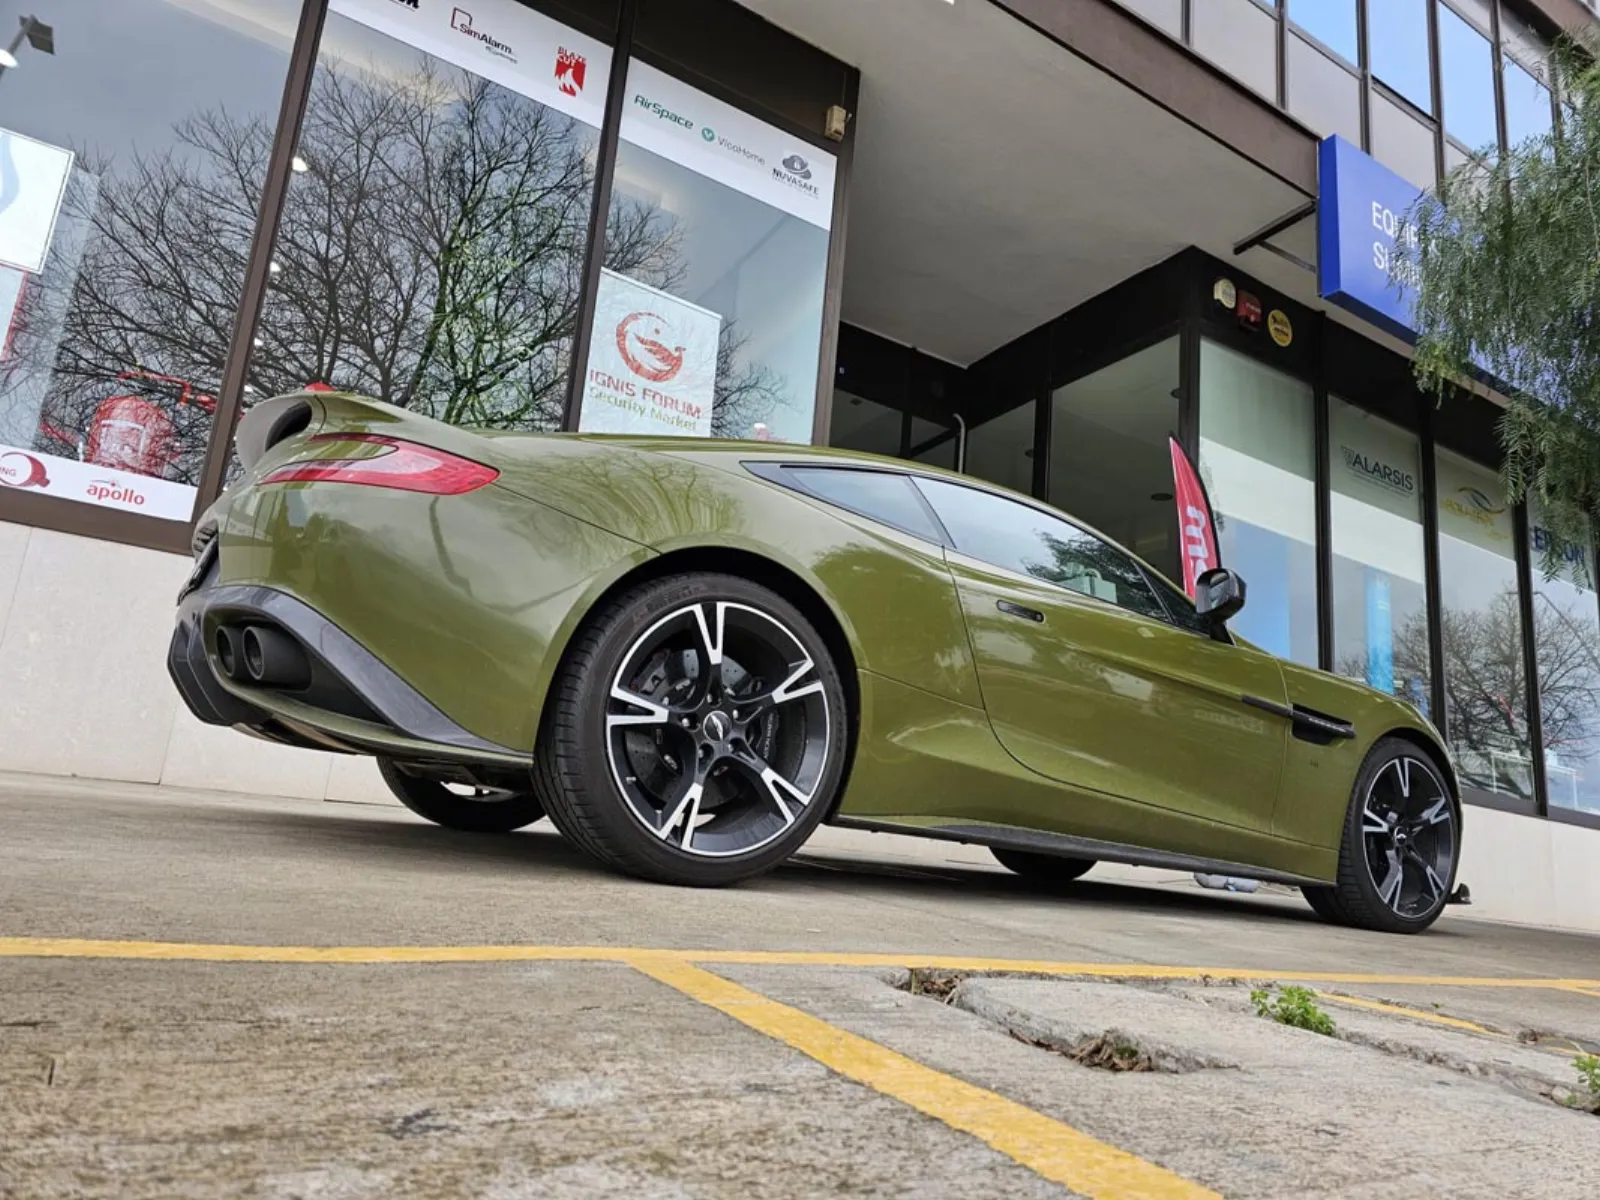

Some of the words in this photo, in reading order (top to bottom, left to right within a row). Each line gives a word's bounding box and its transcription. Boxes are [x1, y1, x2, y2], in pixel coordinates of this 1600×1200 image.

[459, 23, 513, 54] SimAlarm
[633, 94, 694, 130] AirSpace
[772, 167, 820, 196] NUVASAFE
[589, 369, 637, 398] IGNIS
[642, 387, 702, 420] FORUM
[589, 386, 647, 417] Security
[650, 406, 698, 431] Market
[1352, 453, 1414, 491] ALARSIS
[86, 484, 145, 505] apollo
